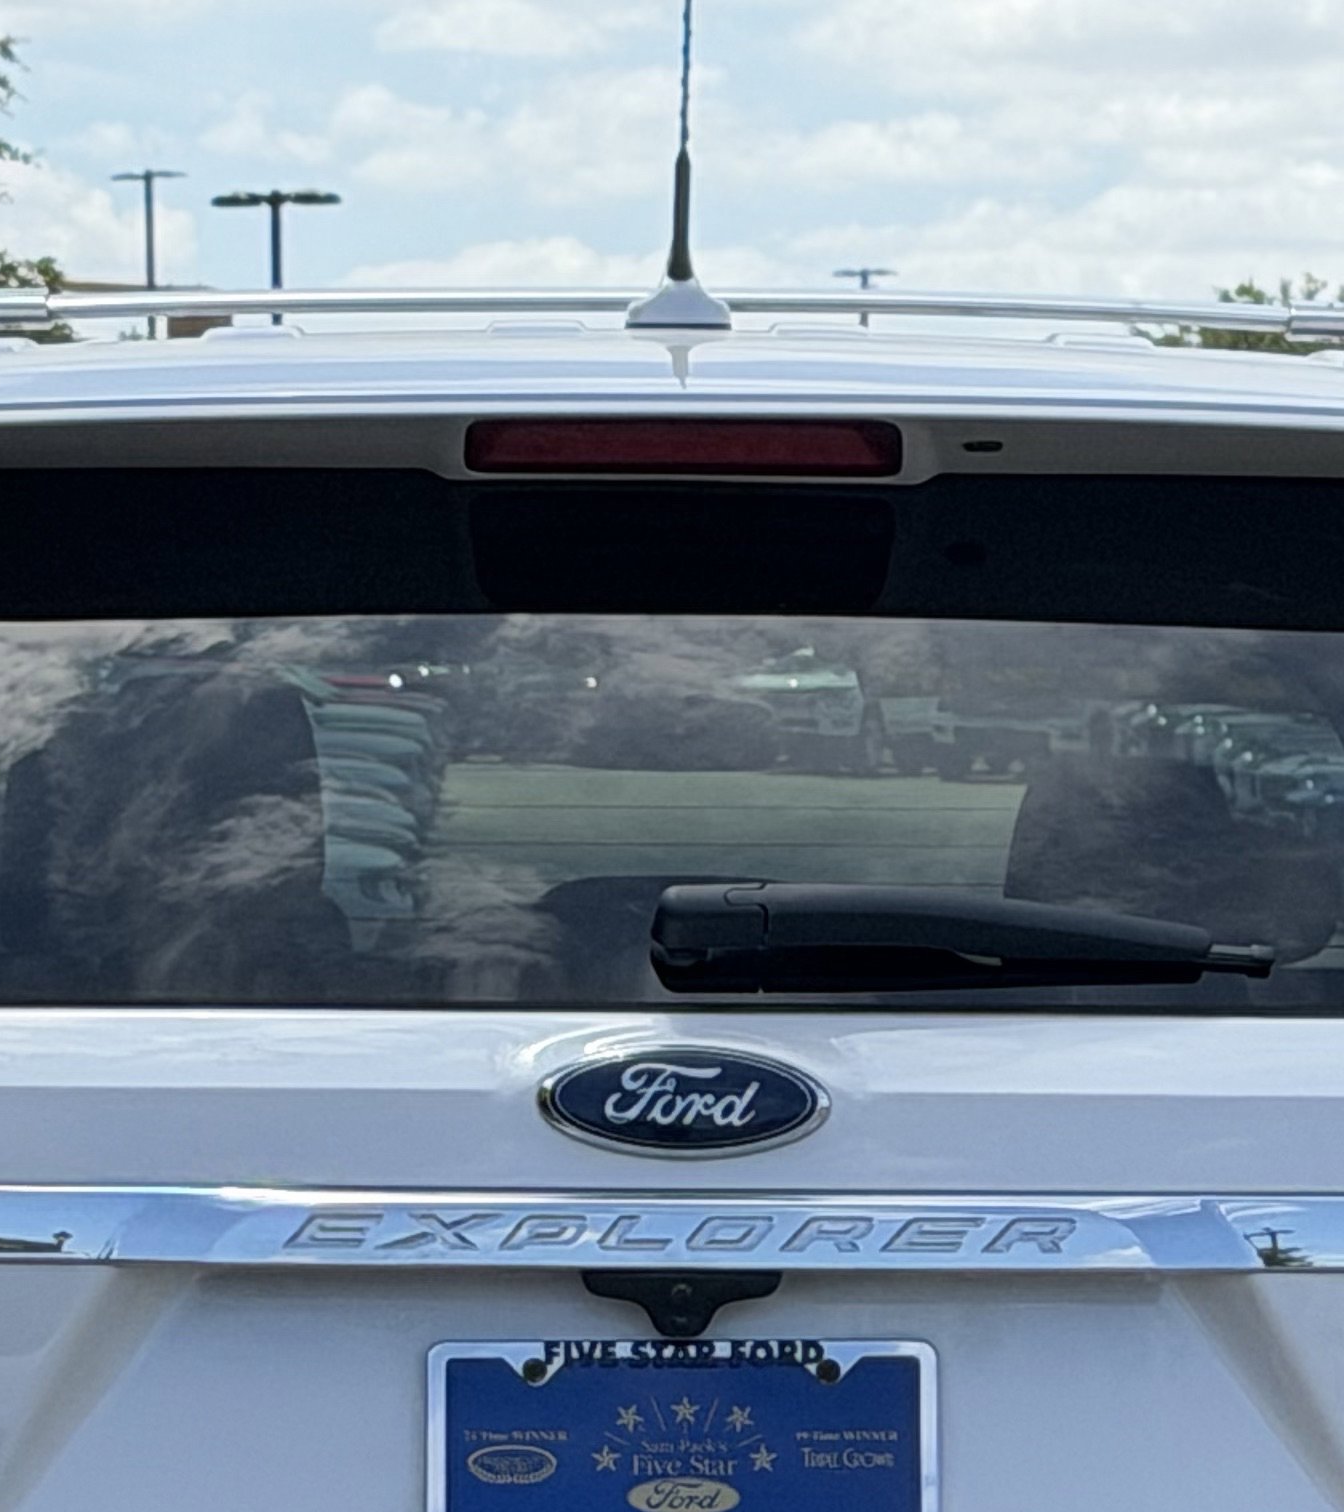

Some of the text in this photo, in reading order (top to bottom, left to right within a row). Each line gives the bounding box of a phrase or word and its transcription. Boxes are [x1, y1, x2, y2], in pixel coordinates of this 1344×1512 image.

[605, 1063, 760, 1127] Ford
[282, 1212, 1078, 1254] EXPLORER
[543, 1340, 825, 1369] FIVE STAR FORD
[632, 1453, 739, 1477] Five Star
[645, 1481, 722, 1510] Ford
